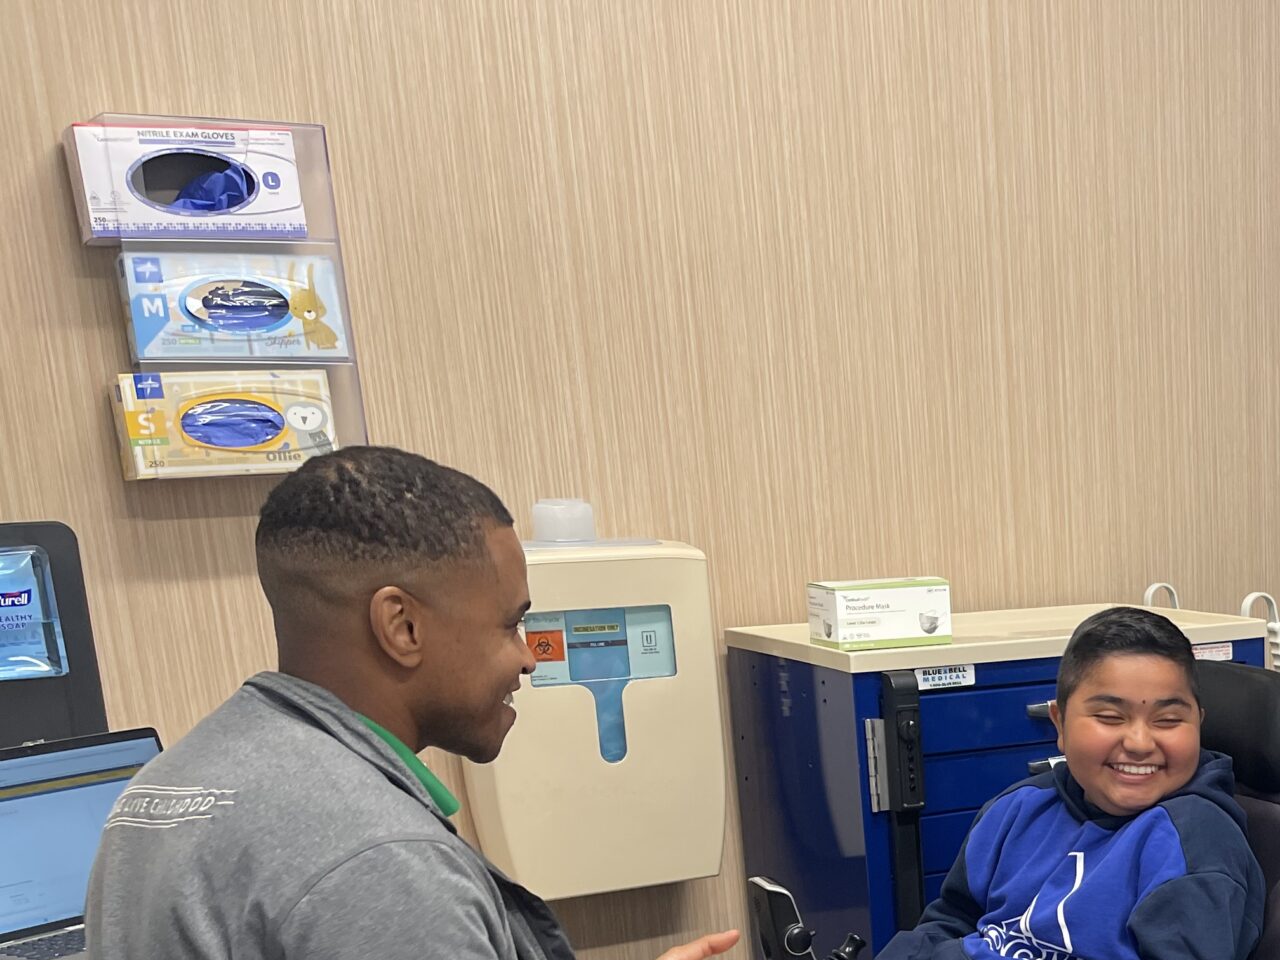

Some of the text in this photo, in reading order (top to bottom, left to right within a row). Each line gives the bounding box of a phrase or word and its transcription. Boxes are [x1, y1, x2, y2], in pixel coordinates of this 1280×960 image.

[137, 130, 171, 138] NITRILE
[173, 131, 199, 139] EXAM
[200, 132, 236, 140] GLOVES
[268, 175, 276, 186] L
[142, 297, 164, 318] M
[137, 412, 156, 435] S
[266, 450, 302, 461] Ollie
[148, 460, 165, 468] 250
[0, 592, 28, 606] urell
[1, 622, 27, 630] SOAP
[922, 668, 942, 676] BLUE
[922, 673, 967, 682] MEDICAL
